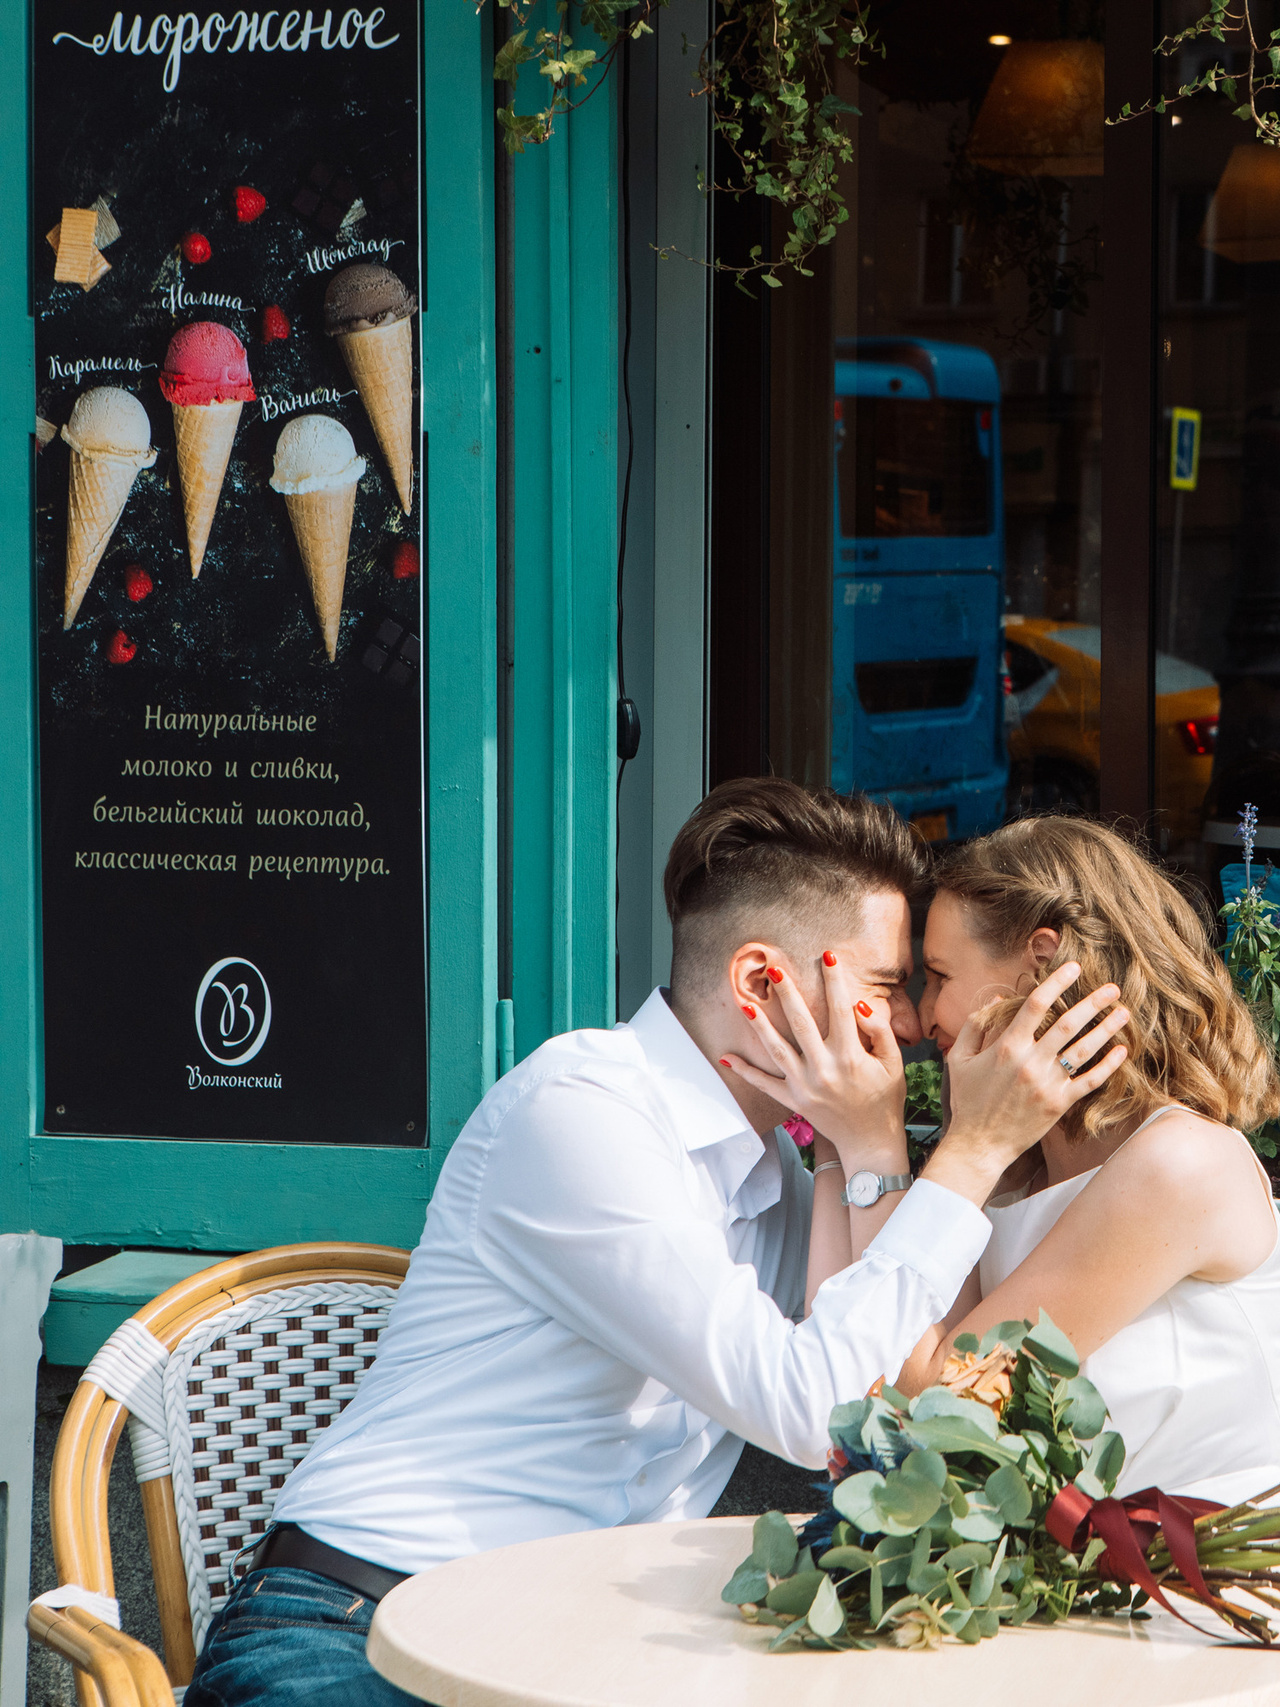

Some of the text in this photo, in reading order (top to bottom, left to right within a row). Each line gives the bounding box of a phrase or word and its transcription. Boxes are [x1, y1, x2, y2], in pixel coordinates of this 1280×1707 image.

[52, 6, 400, 93] мороженое
[305, 237, 405, 274] Шоколад
[161, 282, 256, 314] Малина
[49, 355, 158, 385] Карамель
[260, 389, 358, 423] Ваниль
[144, 705, 317, 738] Натуральные
[121, 757, 340, 784] молоко и сливки,
[93, 796, 371, 832] бельгийский шоколад,
[75, 849, 391, 883] классическая рецептура.
[185, 1065, 282, 1090] Волконский
